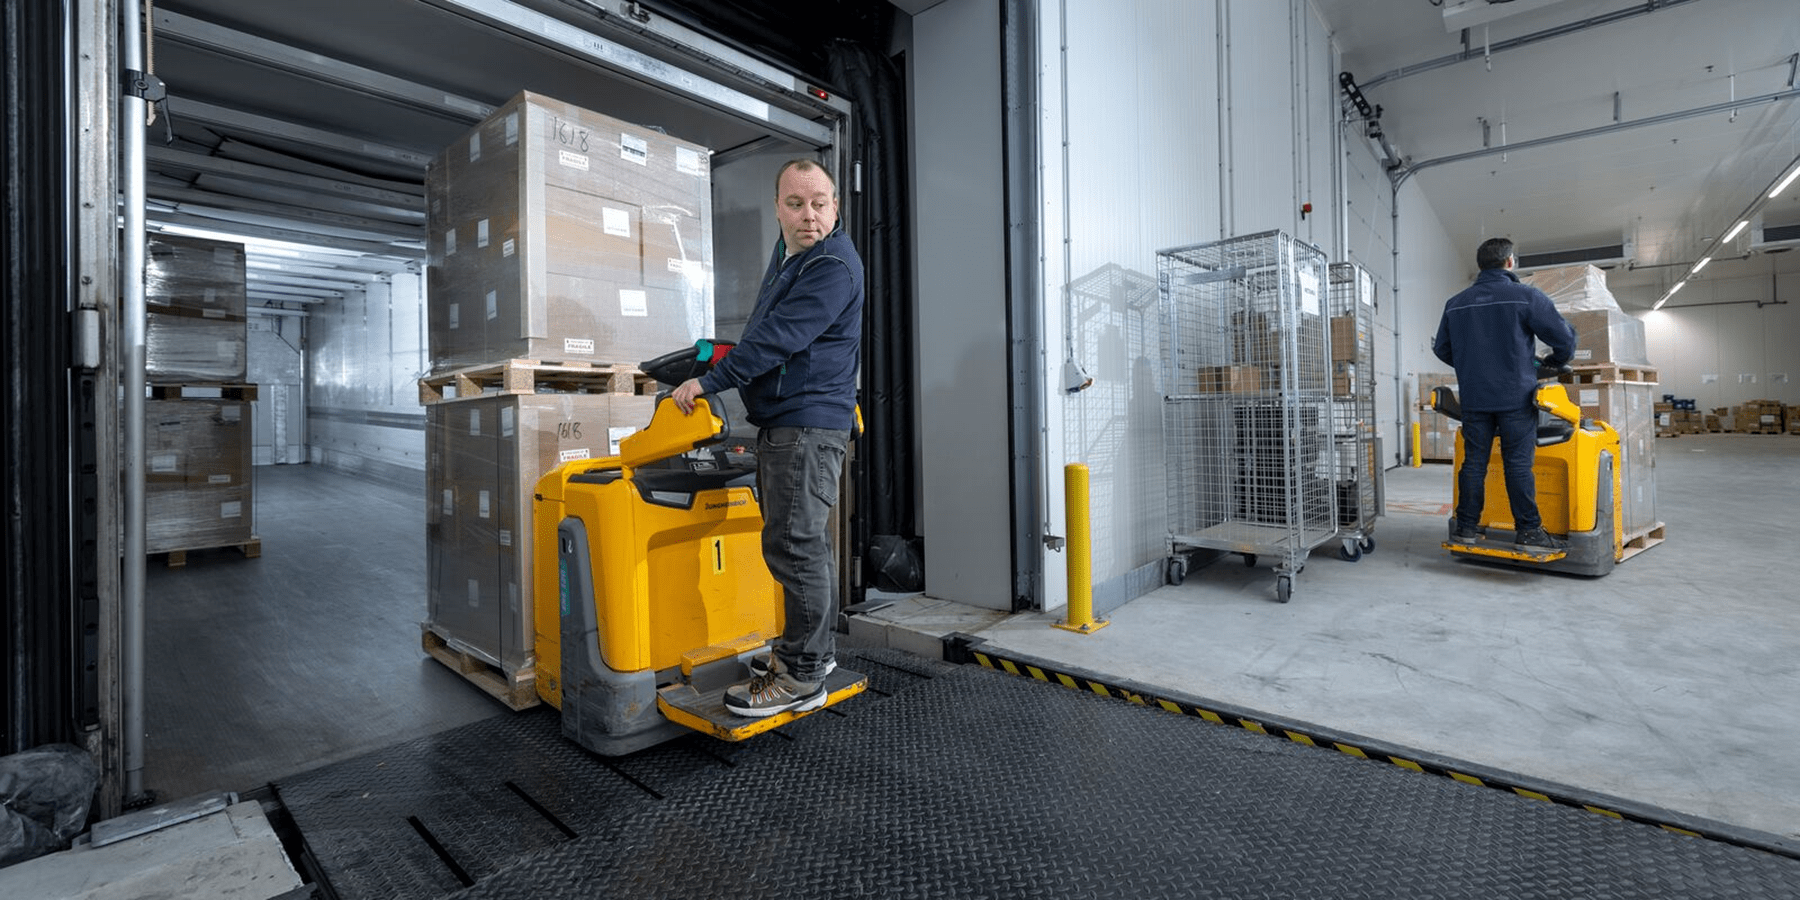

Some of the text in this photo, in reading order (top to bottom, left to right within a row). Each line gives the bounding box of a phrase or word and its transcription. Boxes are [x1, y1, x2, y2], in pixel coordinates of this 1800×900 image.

[553, 116, 589, 152] 1618
[557, 422, 583, 440] 1618
[714, 539, 722, 571] 1
